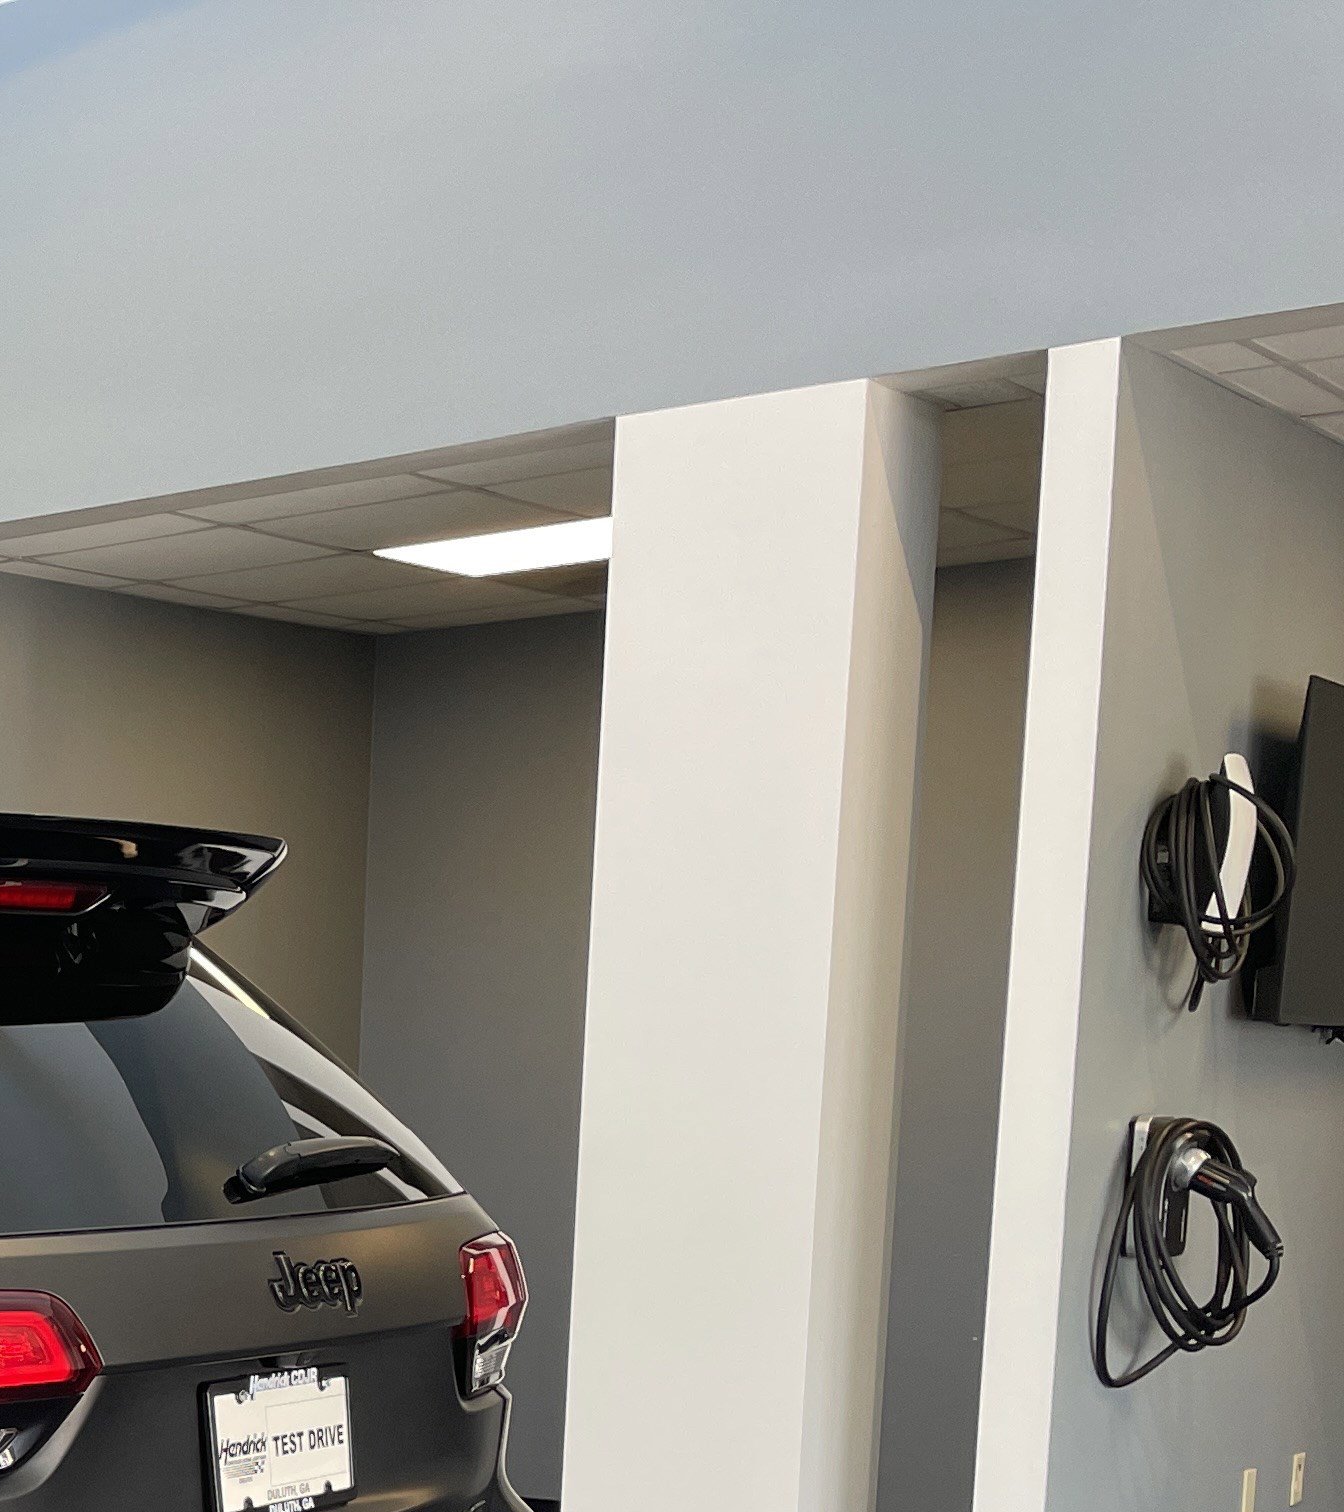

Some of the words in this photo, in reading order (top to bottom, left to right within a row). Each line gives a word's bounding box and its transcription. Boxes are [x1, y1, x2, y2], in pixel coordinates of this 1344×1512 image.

[268, 1250, 363, 1318] Jeep
[219, 1431, 268, 1465] Hendrick
[272, 1431, 304, 1457] TEST
[309, 1424, 344, 1450] DRIVE
[267, 1485, 297, 1501] DULUTH,
[299, 1482, 310, 1494] GA
[302, 1497, 315, 1512] GA
